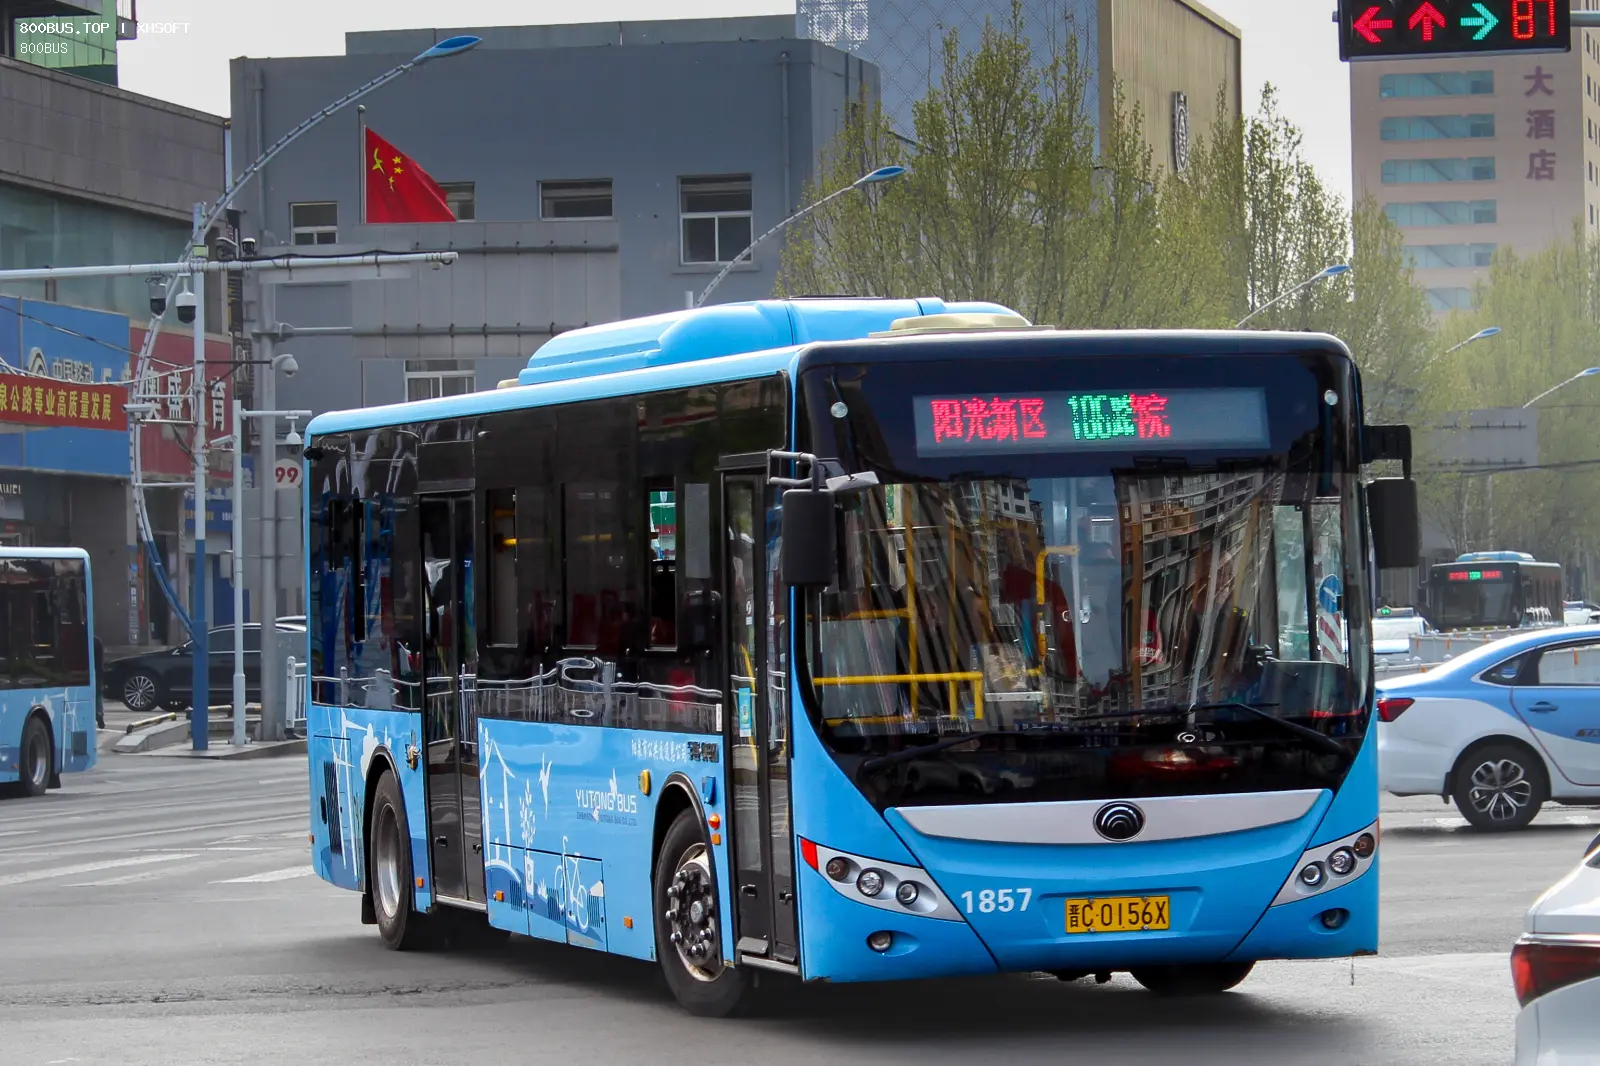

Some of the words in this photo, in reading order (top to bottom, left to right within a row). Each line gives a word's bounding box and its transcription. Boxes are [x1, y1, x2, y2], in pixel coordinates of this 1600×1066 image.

[1523, 65, 1557, 182] 大酒店
[930, 395, 1048, 443] 阳光新区
[575, 789, 615, 811] YUTONG
[617, 793, 637, 814] BUS
[961, 887, 1033, 914] 1857
